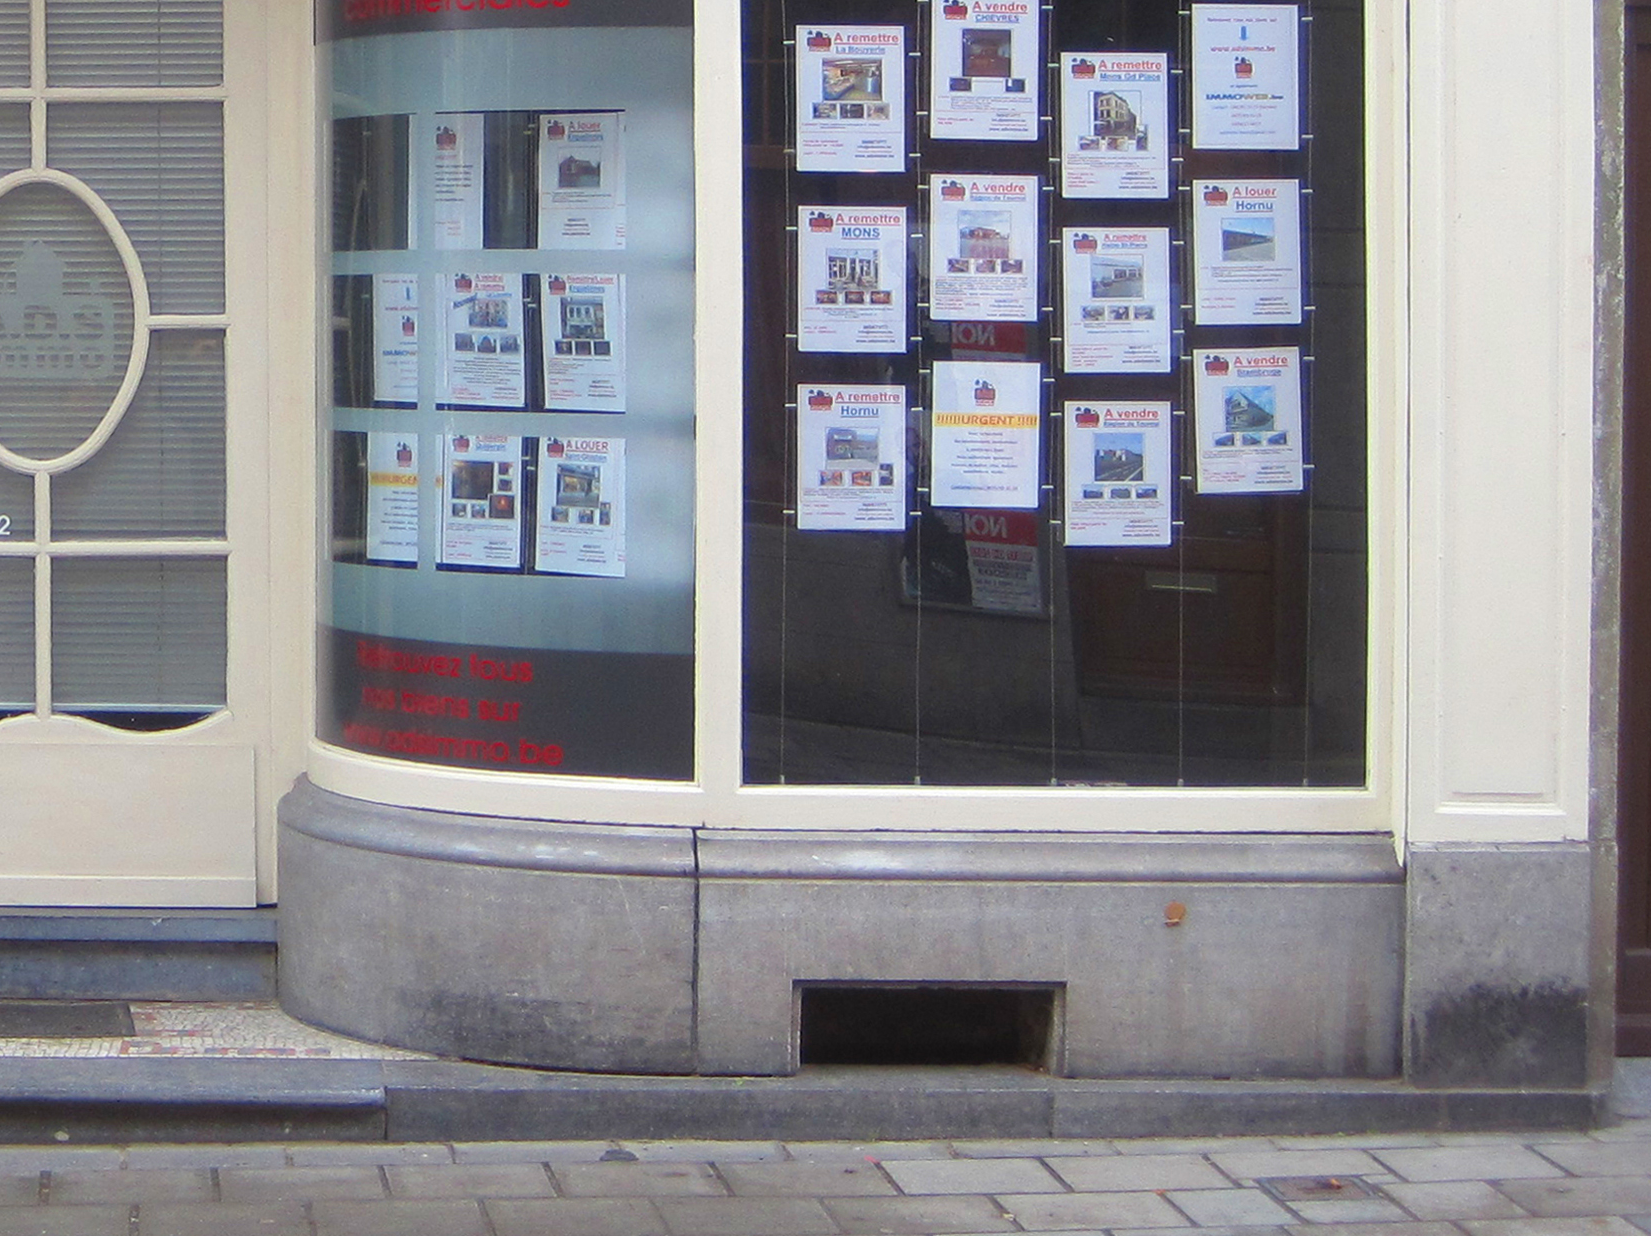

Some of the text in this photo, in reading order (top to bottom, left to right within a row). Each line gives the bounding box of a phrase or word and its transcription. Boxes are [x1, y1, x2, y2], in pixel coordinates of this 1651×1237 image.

[973, 1, 1028, 12] A vendre
[834, 33, 899, 43] A remettre
[1099, 61, 1162, 71] A remettre
[971, 182, 1026, 192] A vendre
[1233, 186, 1277, 196] A louer
[1236, 201, 1274, 210] Hornu
[836, 213, 901, 223] A remettre
[842, 227, 880, 237] MONS
[1235, 355, 1288, 365] A vendre
[836, 392, 901, 402] A remettre
[841, 405, 879, 415] Hornu
[1104, 408, 1159, 418] A vendre
[566, 440, 609, 451] A LOUER
[469, 653, 534, 682] tous
